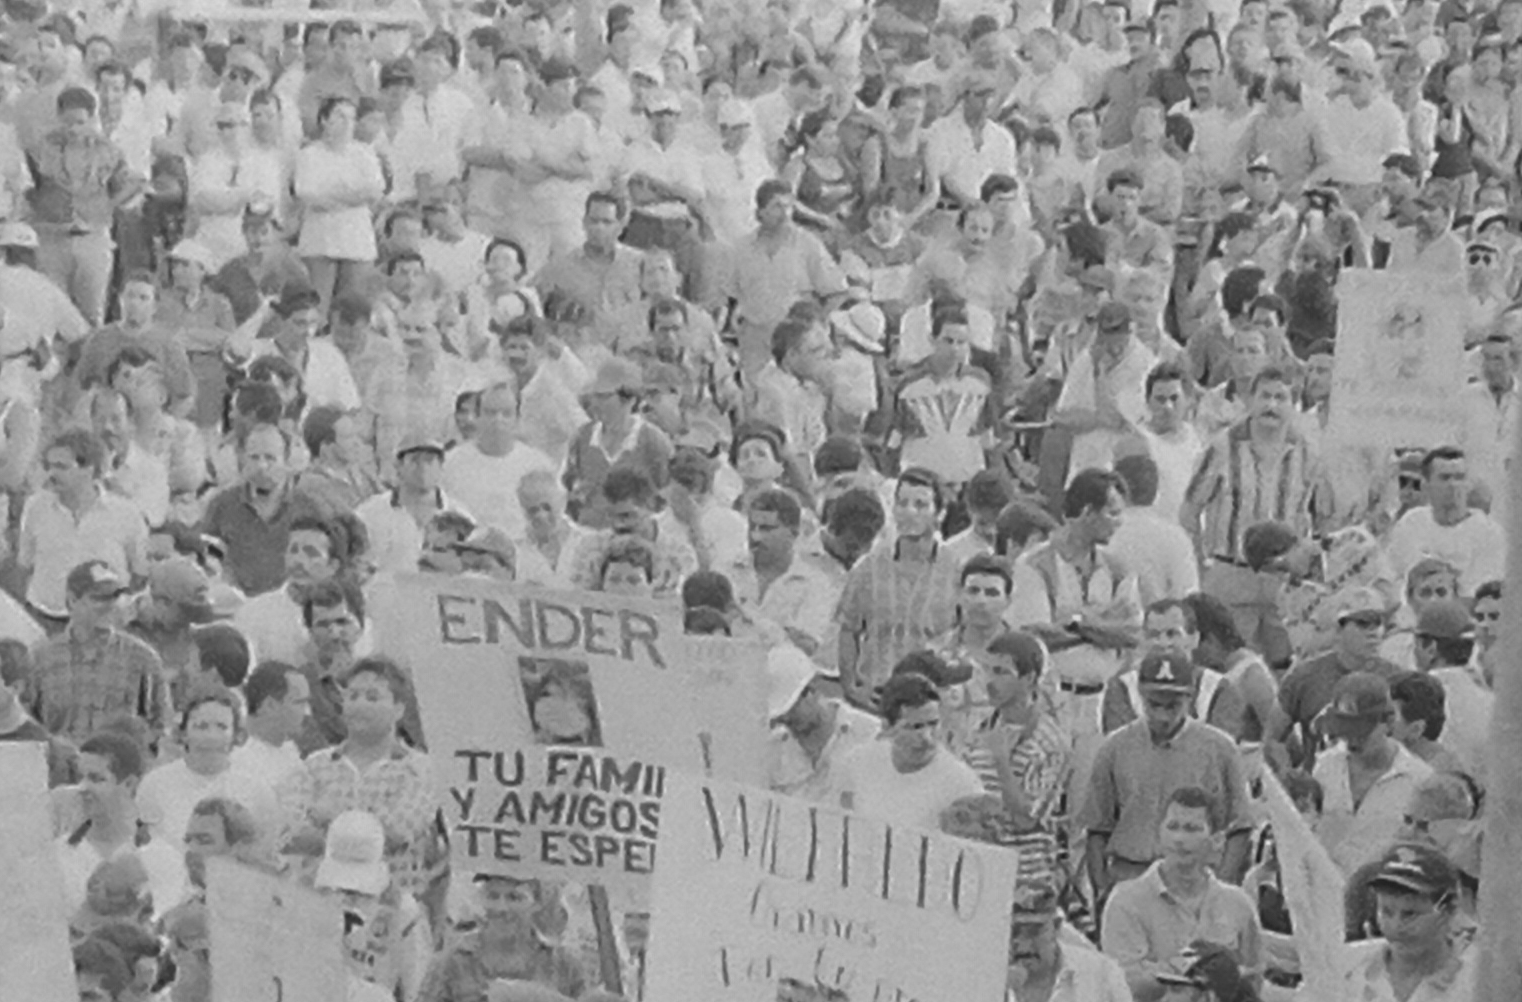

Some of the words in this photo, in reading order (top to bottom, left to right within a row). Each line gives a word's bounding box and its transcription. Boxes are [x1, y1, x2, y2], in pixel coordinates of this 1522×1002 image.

[437, 594, 666, 670] ENDER
[454, 749, 525, 787] TU
[450, 786, 476, 822] Y
[494, 790, 661, 840] AMIGOS
[455, 823, 522, 862] TE
